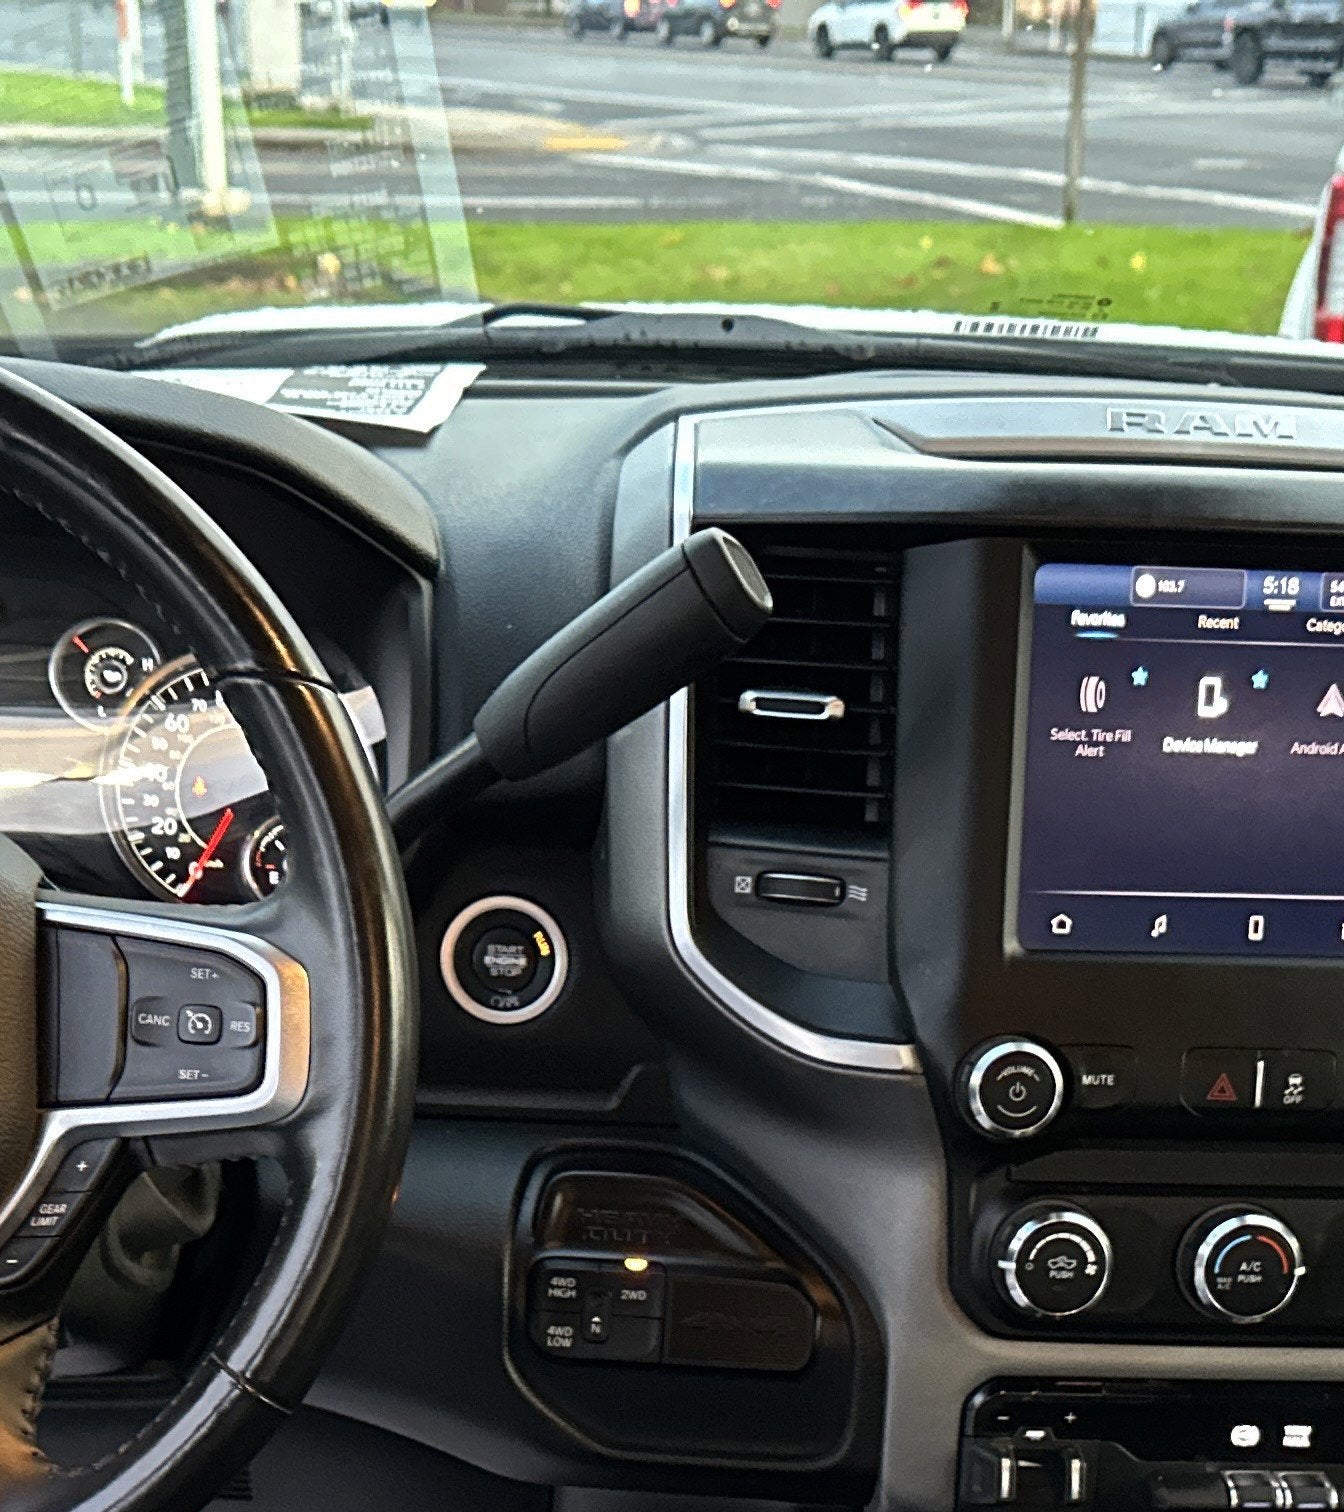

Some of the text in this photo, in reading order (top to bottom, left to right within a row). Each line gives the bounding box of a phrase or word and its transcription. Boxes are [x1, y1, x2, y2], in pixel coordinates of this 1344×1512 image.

[1106, 407, 1296, 439] RAM
[1262, 575, 1300, 595] 5:18
[1070, 609, 1126, 628] Favorites
[1197, 614, 1240, 630] Recent
[164, 712, 190, 733] 60
[1091, 728, 1114, 743] Tire
[1114, 728, 1132, 743] Fill
[1074, 743, 1106, 757] Alert
[1162, 735, 1259, 758] Device Manager
[1289, 741, 1338, 755] Android
[151, 816, 178, 835] 20
[138, 1012, 171, 1028] CANC
[230, 1019, 252, 1032] RES
[1081, 1074, 1116, 1087] MUTE
[1282, 1095, 1304, 1105] OFF
[39, 1203, 68, 1215] GEAR
[29, 1215, 59, 1227] LIMIT
[1239, 1260, 1262, 1273] A/C
[1049, 1269, 1075, 1279] PUSH
[1237, 1273, 1263, 1284] PUSH
[550, 1276, 577, 1289] 4WD
[547, 1287, 577, 1299] HIGH
[621, 1289, 647, 1302] 2WD
[546, 1325, 573, 1338] 4WD
[590, 1323, 602, 1335] N
[546, 1336, 573, 1349] LOW
